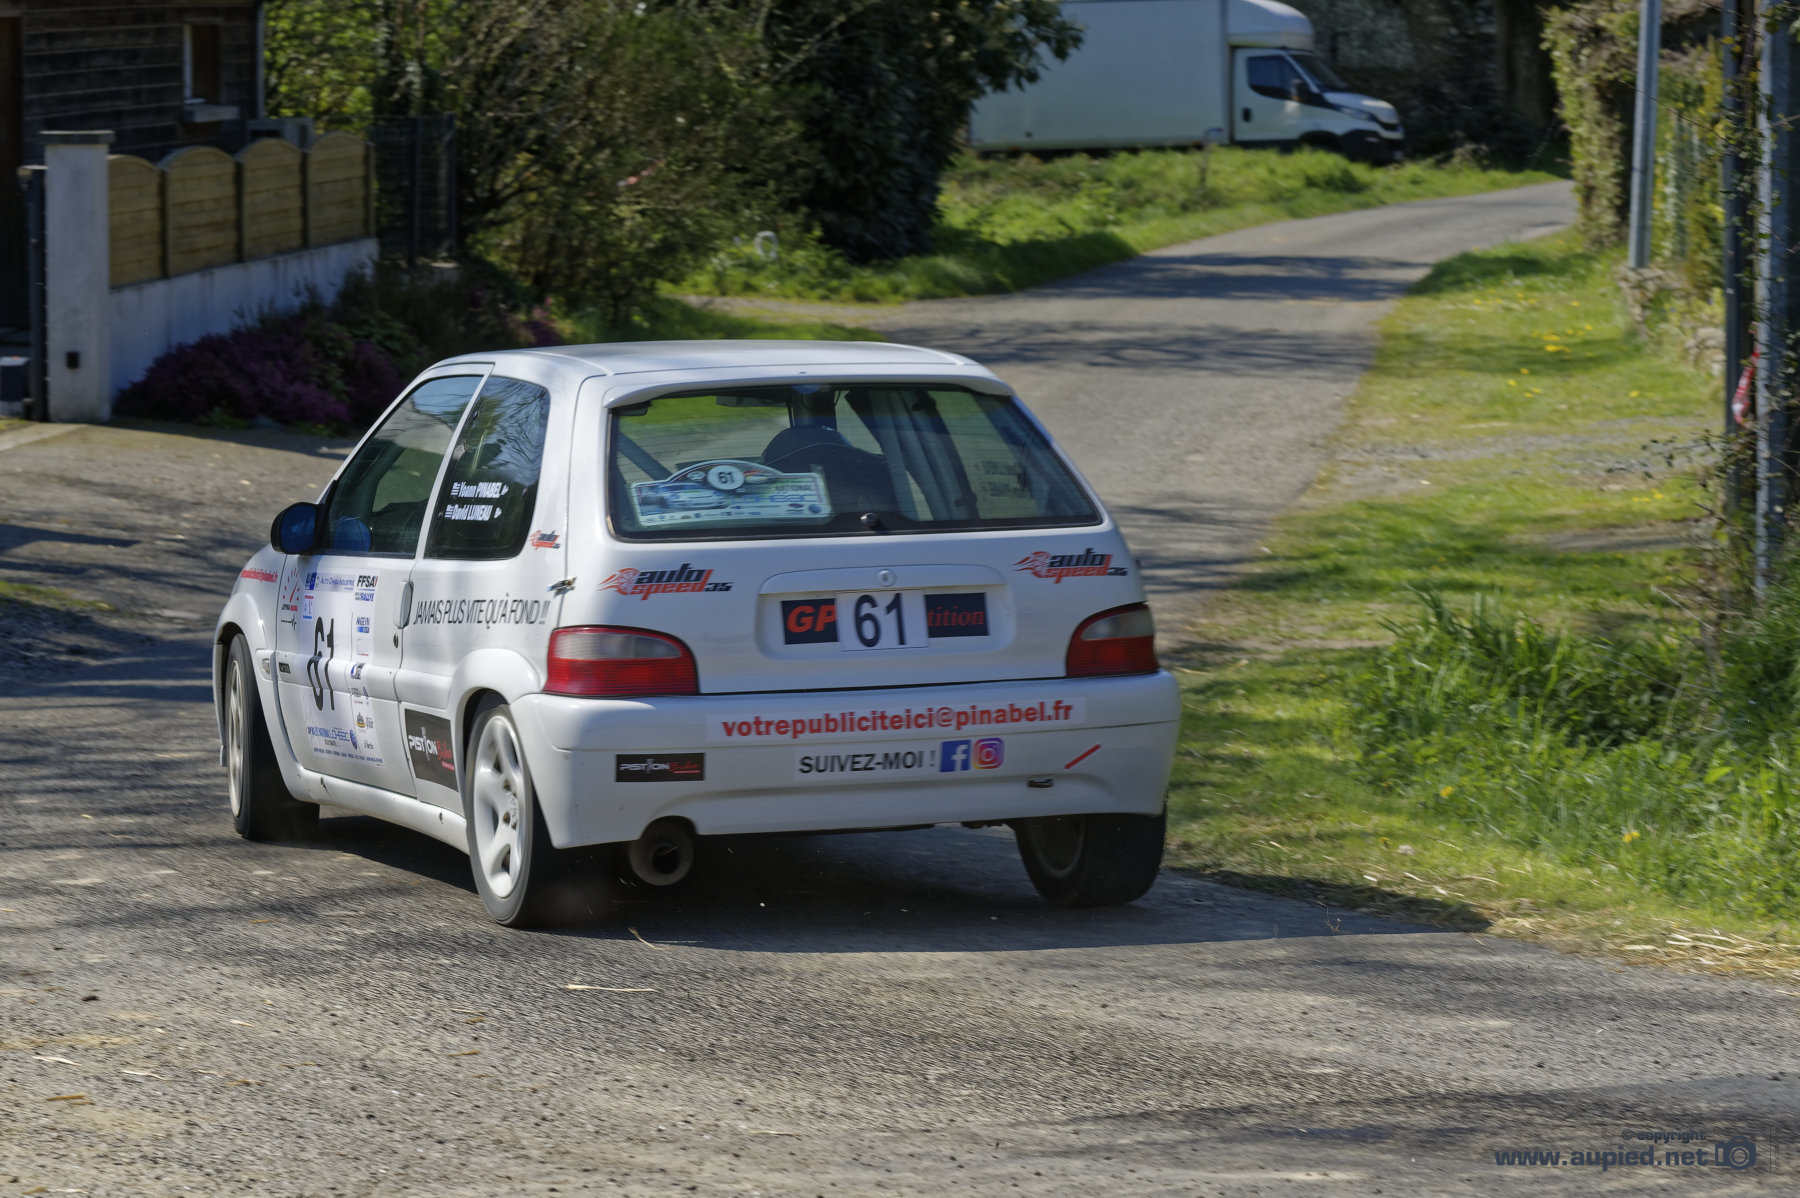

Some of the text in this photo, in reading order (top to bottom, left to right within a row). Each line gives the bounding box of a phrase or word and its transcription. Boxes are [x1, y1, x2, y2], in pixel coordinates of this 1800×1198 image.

[718, 471, 735, 484] 61
[356, 575, 376, 588] FFSA
[630, 569, 714, 601] speed
[634, 562, 707, 584] auto
[413, 599, 444, 625] JAMAIS
[442, 599, 467, 625] PLUS
[466, 599, 487, 625] VITE
[507, 599, 541, 625] FOND
[854, 592, 908, 648] 61
[721, 700, 1074, 739] votrepubliciteici@pinabel.fr
[799, 750, 924, 774] SUIVEZ-MOI
